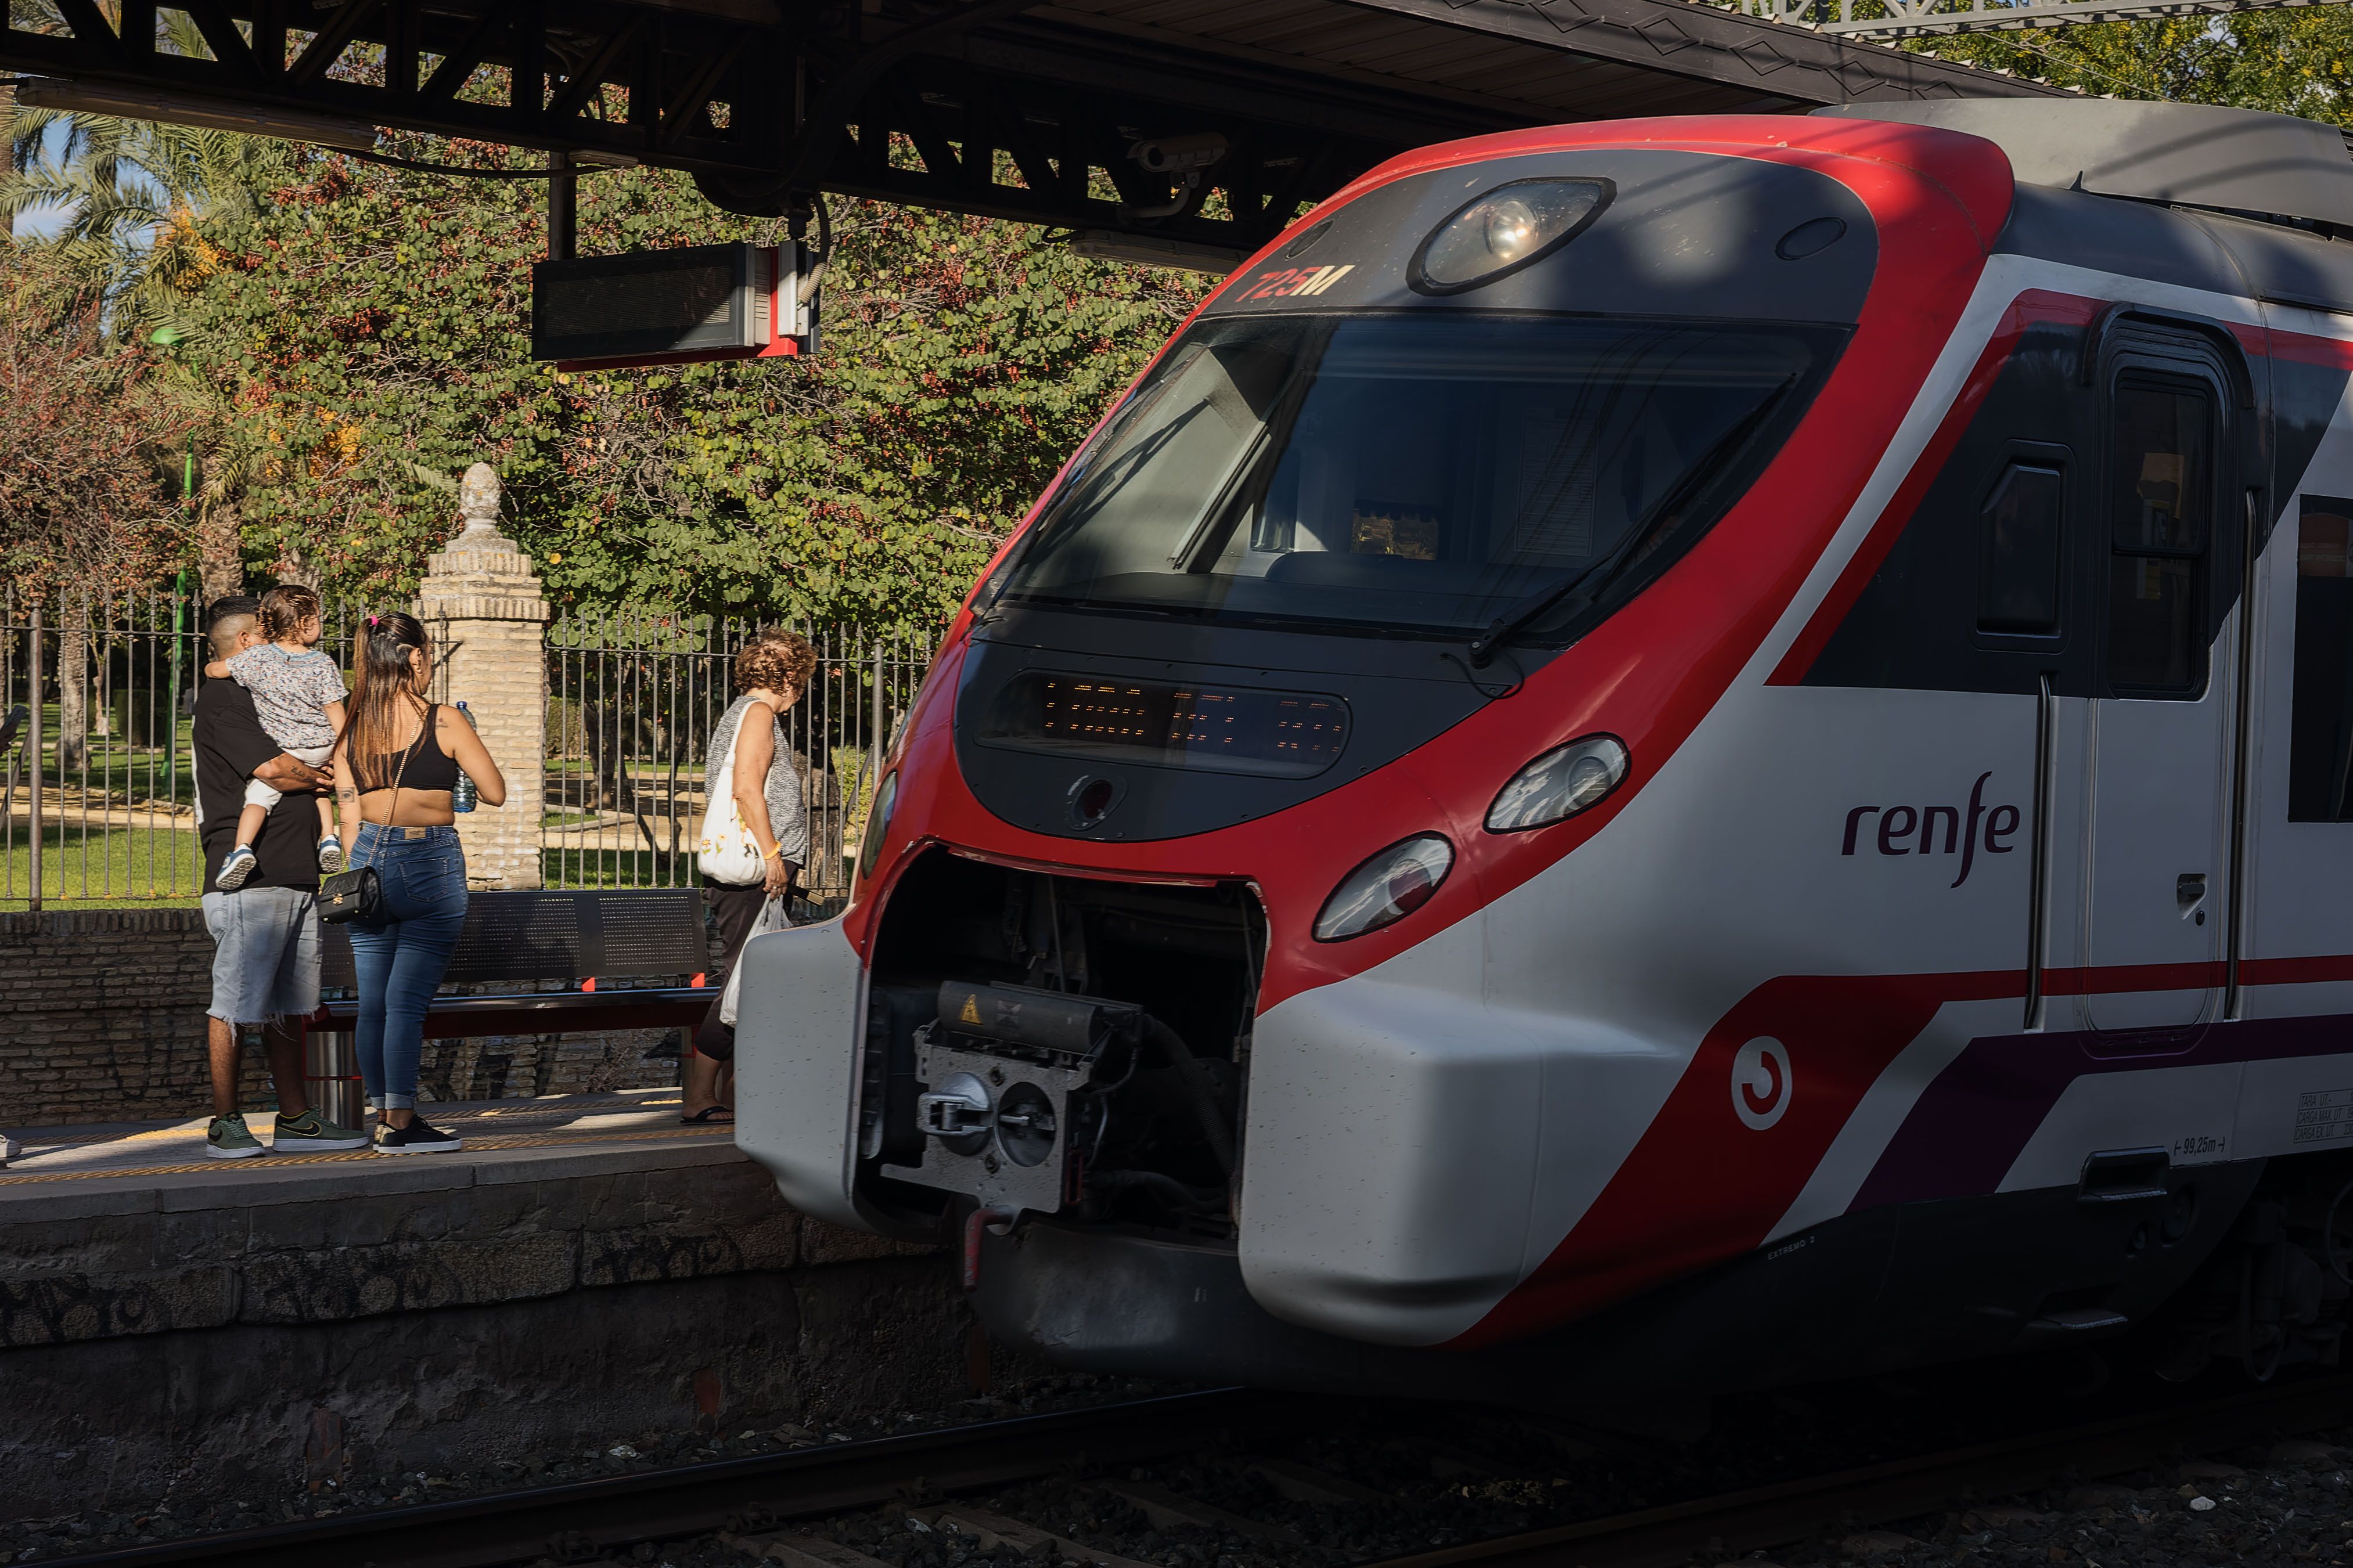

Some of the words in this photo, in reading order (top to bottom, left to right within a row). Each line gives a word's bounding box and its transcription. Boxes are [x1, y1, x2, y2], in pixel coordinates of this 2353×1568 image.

[1841, 770, 2021, 889] renfe
[2301, 1094, 2316, 1108] TARA
[2298, 1110, 2318, 1124] CARGA
[2295, 1126, 2315, 1141] CARGA
[2183, 1136, 2216, 1156] 99,25m
[1767, 1239, 1806, 1260] EXTREMO
[1809, 1235, 1816, 1243] 2
